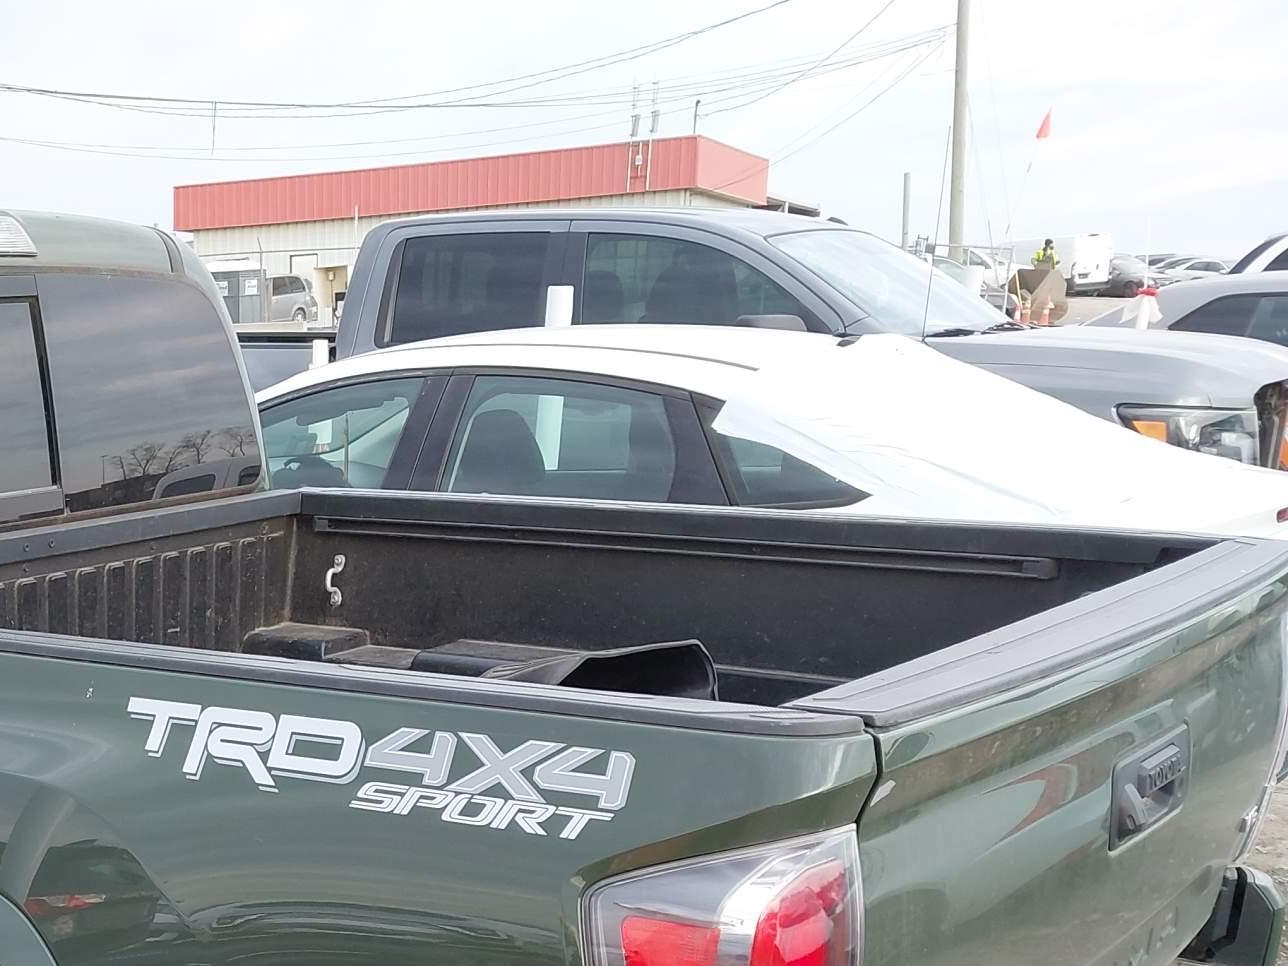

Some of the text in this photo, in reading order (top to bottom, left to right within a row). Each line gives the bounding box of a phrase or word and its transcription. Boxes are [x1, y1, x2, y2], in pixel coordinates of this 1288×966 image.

[127, 696, 637, 811] TRD 4X4
[349, 781, 615, 840] SPORT
